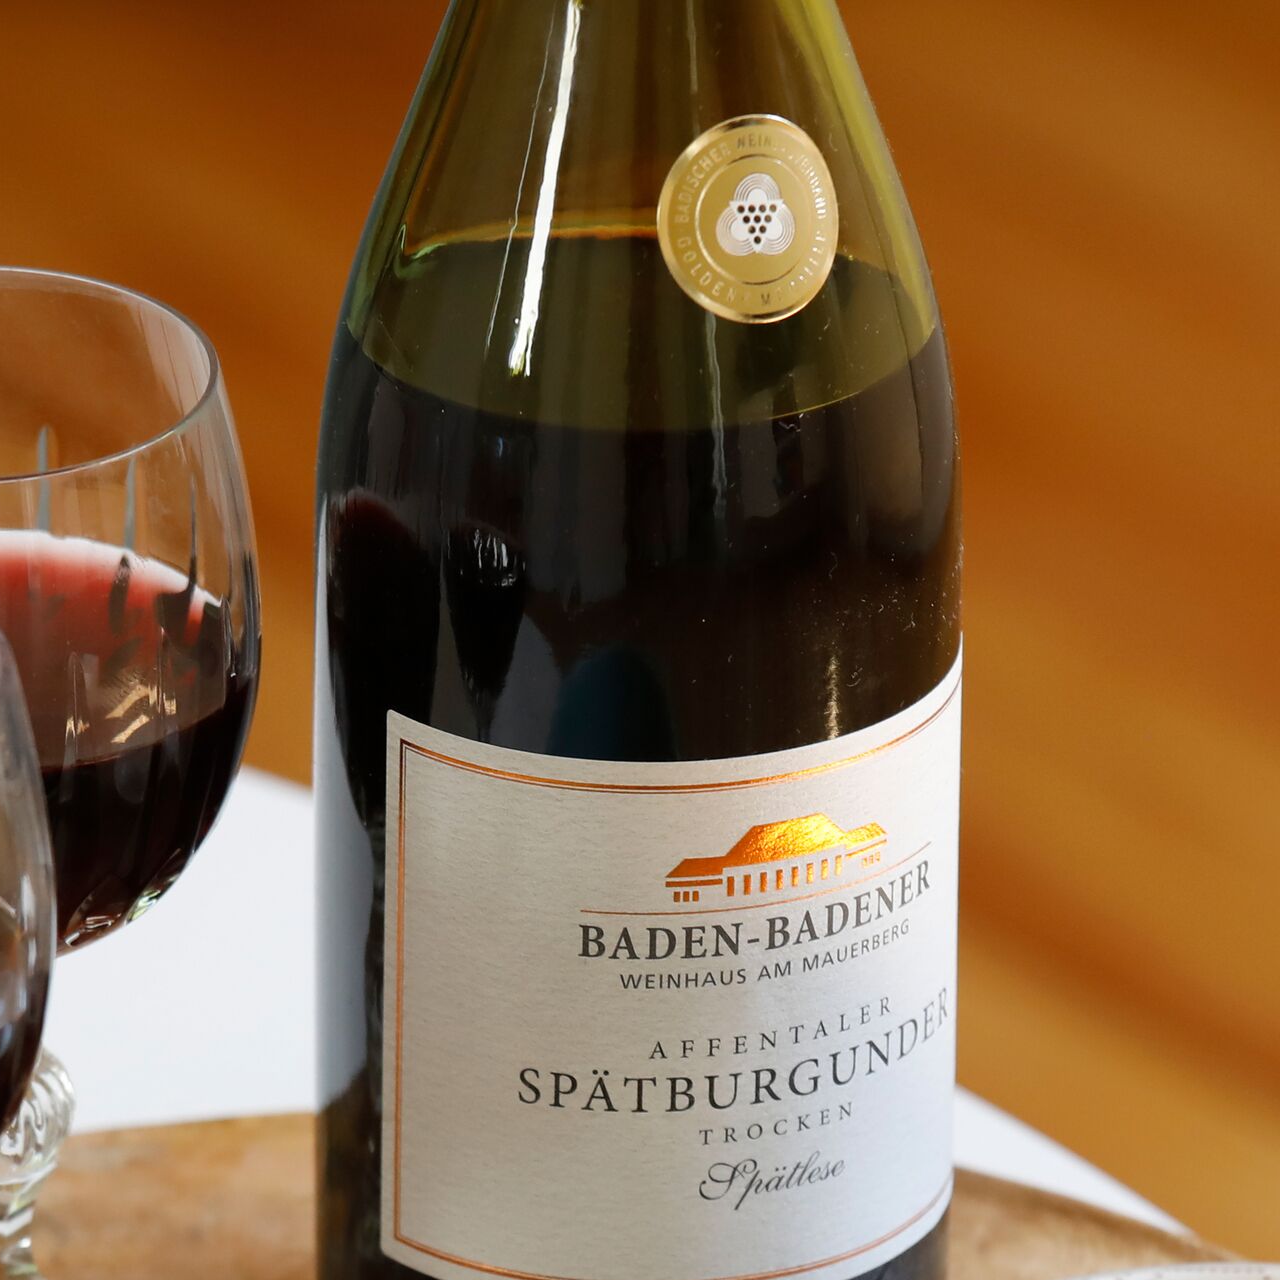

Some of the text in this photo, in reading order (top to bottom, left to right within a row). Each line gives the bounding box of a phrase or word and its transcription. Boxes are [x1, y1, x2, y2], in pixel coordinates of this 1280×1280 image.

[674, 142, 732, 224] BADISCHER
[577, 859, 931, 960] BADEN-BADENER
[620, 918, 910, 990] WEINHAUS AM MAUERBERG
[517, 987, 949, 1114] SPÄTBURGUNDER
[649, 996, 891, 1060] AFFENTALER
[698, 1101, 854, 1146] TROCKEN
[698, 1150, 845, 1210] Spätlese
